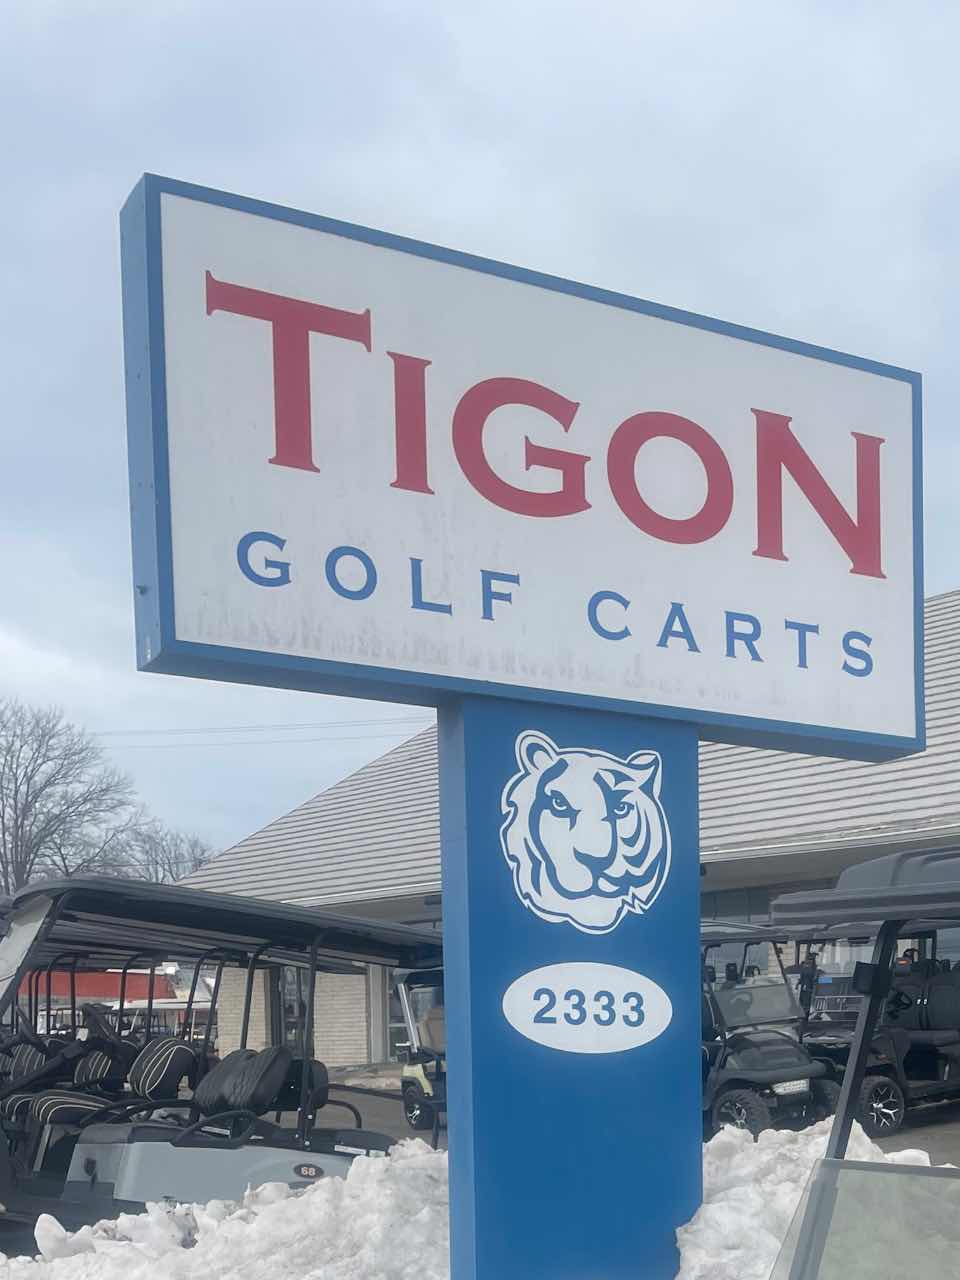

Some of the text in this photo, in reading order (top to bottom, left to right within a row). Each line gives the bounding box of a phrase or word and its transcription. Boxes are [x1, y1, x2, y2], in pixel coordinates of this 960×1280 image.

[205, 269, 887, 580] TIGON
[236, 530, 875, 679] GOLF CARTS
[532, 986, 646, 1028] 2333
